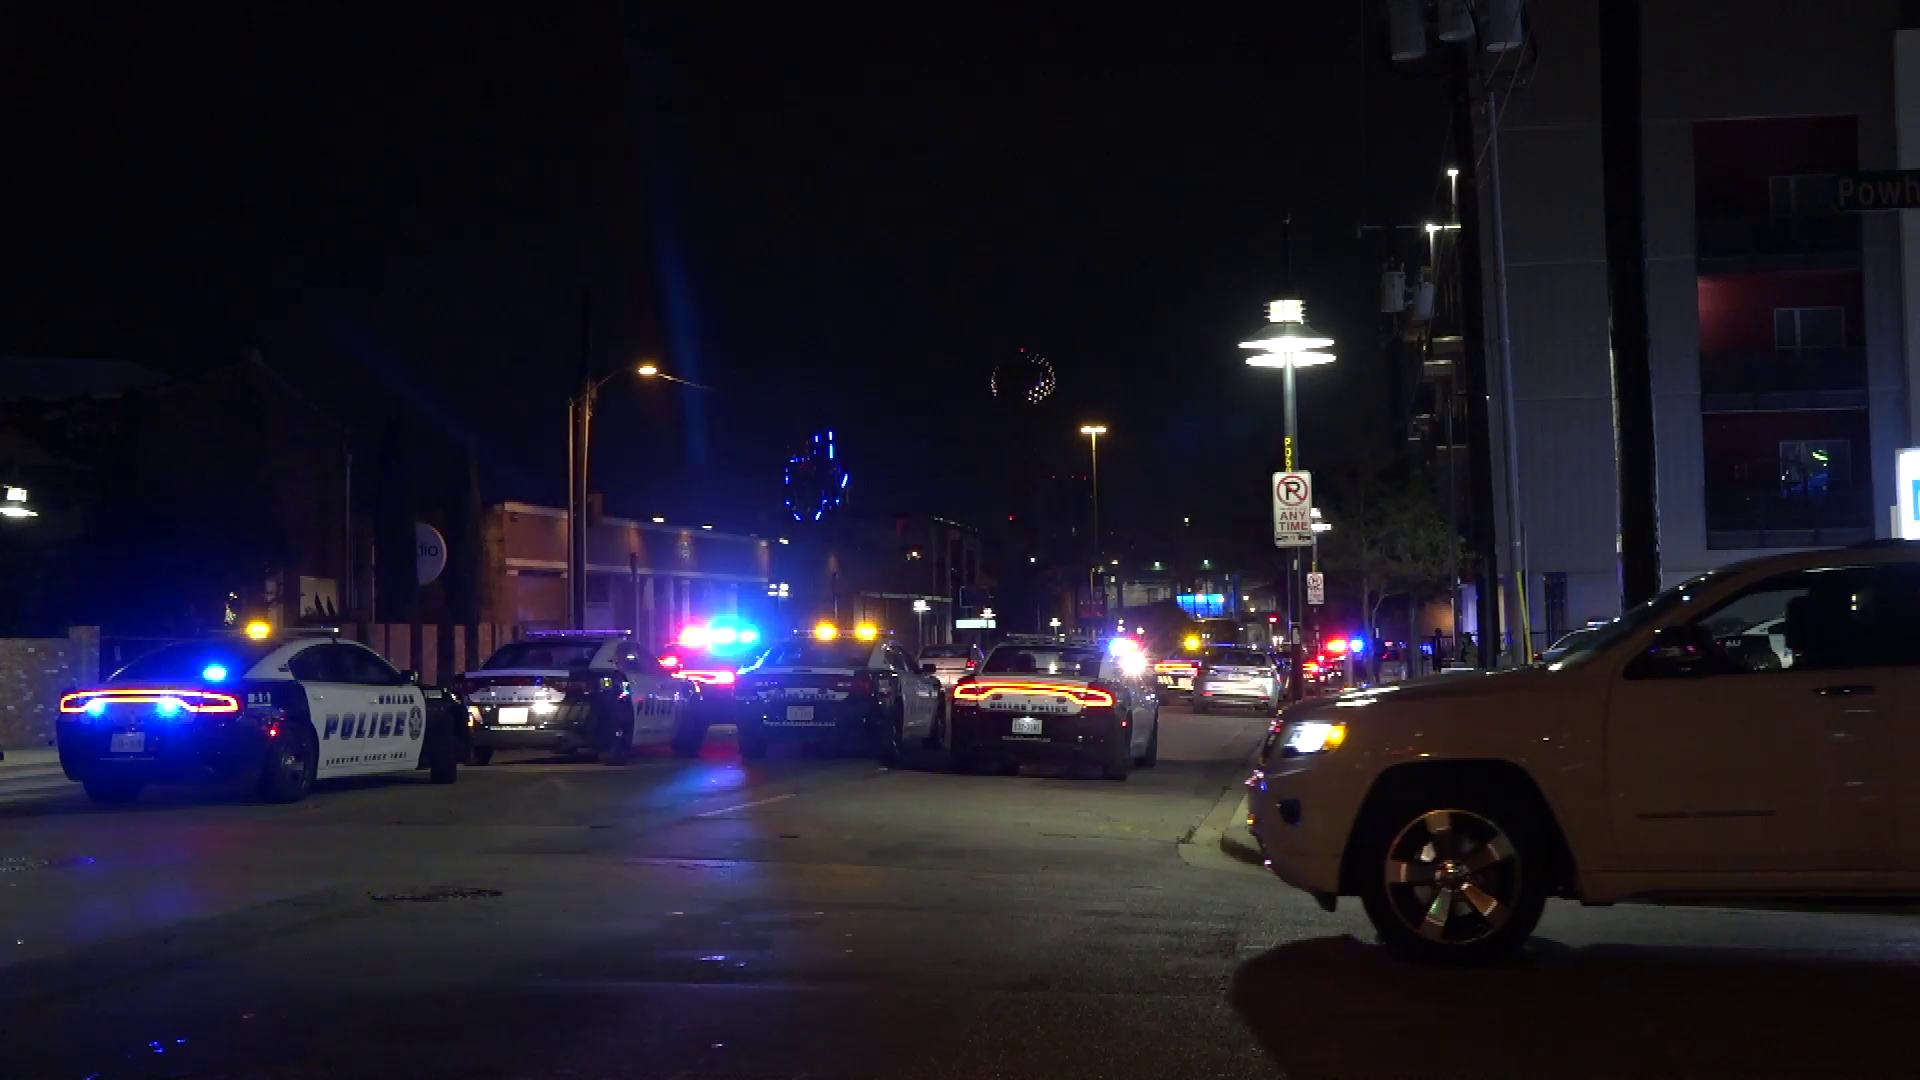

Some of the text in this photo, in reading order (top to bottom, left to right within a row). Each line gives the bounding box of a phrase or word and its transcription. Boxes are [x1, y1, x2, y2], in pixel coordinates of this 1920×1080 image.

[1839, 173, 1920, 206] Powh
[1278, 521, 1309, 531] TIME
[1279, 511, 1306, 521] ANY
[323, 711, 407, 741] POLICE
